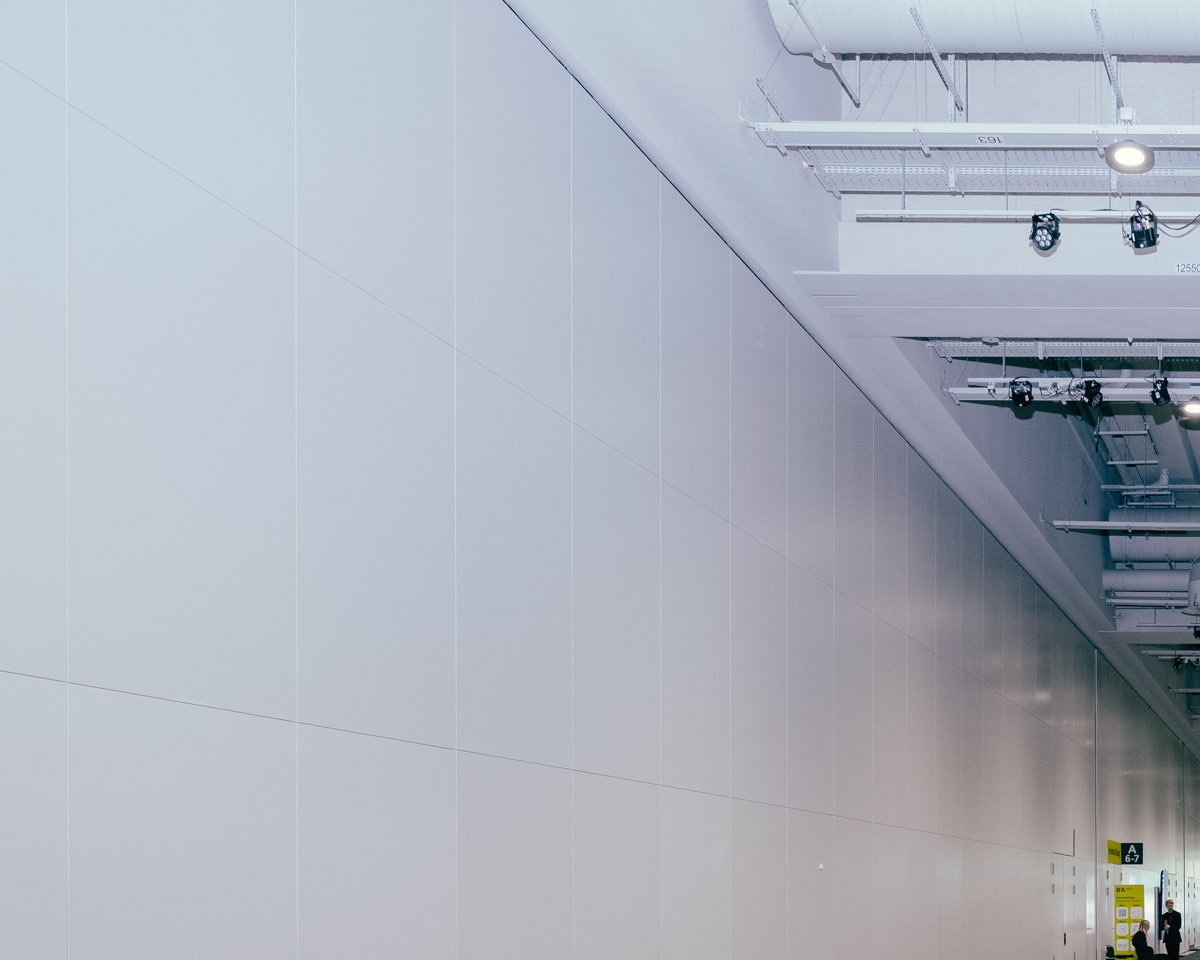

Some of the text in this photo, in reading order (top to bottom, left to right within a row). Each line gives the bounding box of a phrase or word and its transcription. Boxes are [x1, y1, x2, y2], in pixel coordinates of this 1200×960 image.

[977, 136, 1003, 144] 163
[1127, 844, 1137, 854] A
[1125, 854, 1140, 863] 6-7
